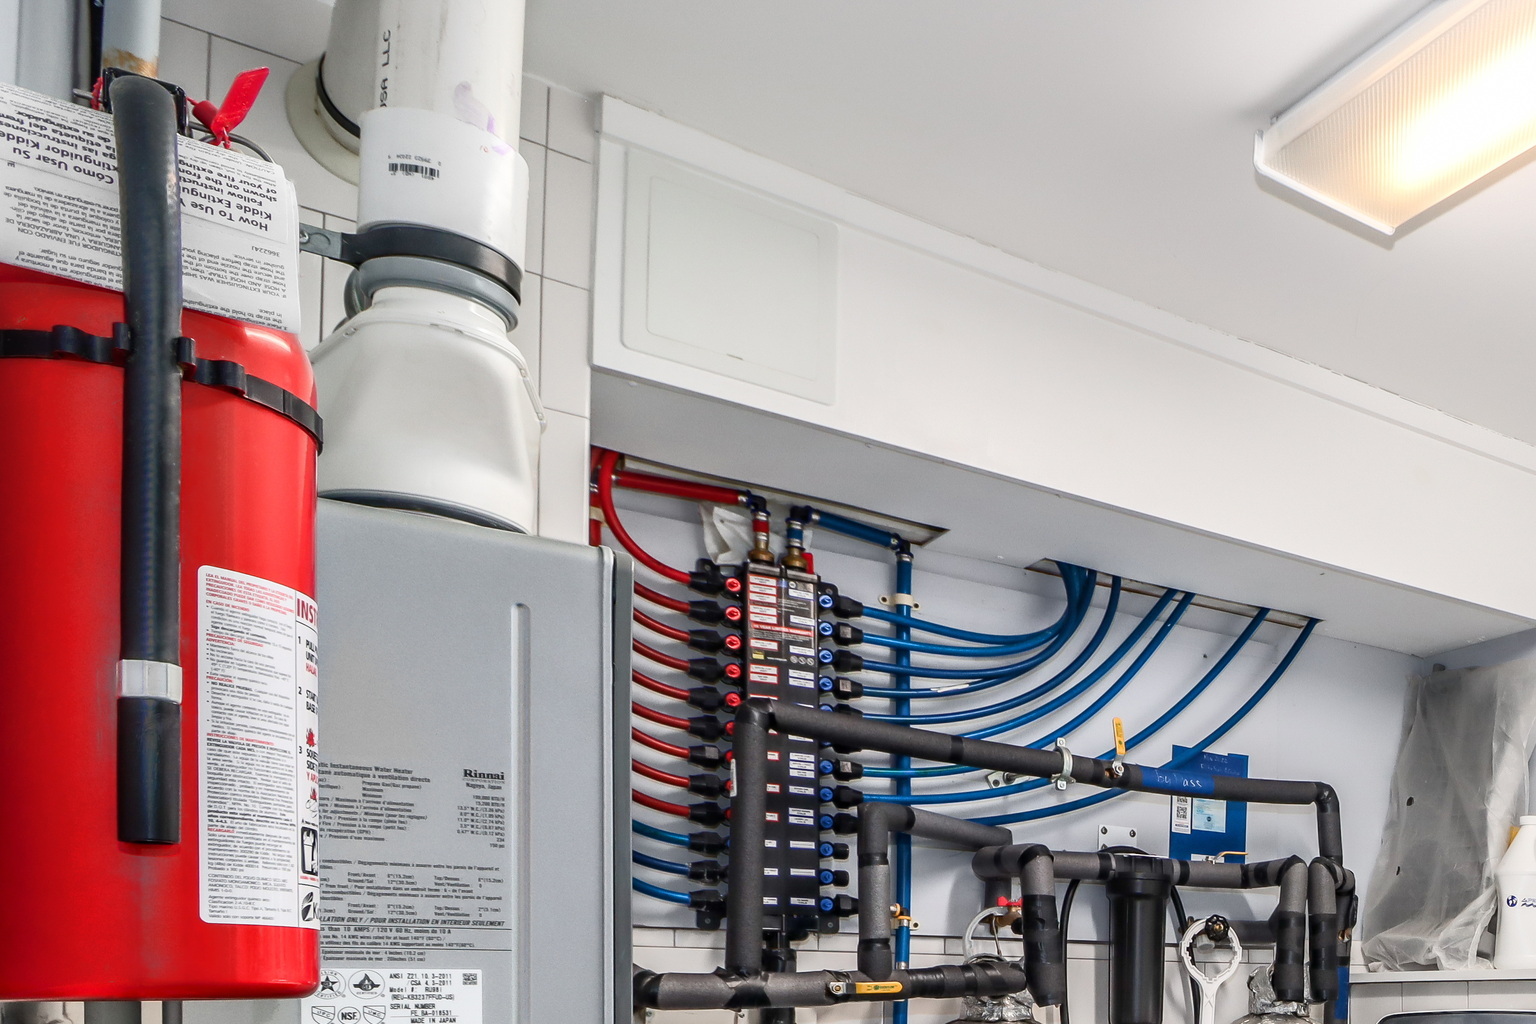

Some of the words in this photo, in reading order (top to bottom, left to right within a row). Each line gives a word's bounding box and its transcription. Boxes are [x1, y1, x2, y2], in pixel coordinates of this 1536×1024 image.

[382, 29, 391, 67] LLC
[0, 114, 24, 125] fren
[29, 122, 48, 131] del
[0, 131, 40, 150] Kidde
[52, 129, 101, 148] etiqueta
[97, 136, 110, 144] de
[12, 148, 30, 160] Su
[82, 146, 98, 156] las
[36, 154, 68, 171] Usar
[44, 146, 119, 173] xtinguidor
[179, 160, 214, 174] exting
[73, 166, 114, 184] Cómo
[179, 168, 201, 180] fron
[217, 172, 236, 182] fire
[180, 176, 224, 194] instructi
[205, 176, 222, 186] the
[226, 182, 240, 190] on
[239, 180, 262, 190] your
[180, 187, 231, 208] Extingu
[227, 191, 262, 206] Follow
[243, 188, 278, 202] shown
[191, 201, 214, 216] Use
[236, 204, 272, 221] Kidde
[219, 210, 234, 222] To
[239, 216, 268, 232] How
[17, 227, 34, 236] CON
[34, 232, 66, 244] ENVIADO
[199, 274, 214, 283] WAS
[230, 276, 246, 284] HOSE
[248, 280, 262, 288] AND
[216, 280, 260, 292] EXTINGUISHER
[220, 307, 230, 315] the
[232, 310, 246, 318] hold
[255, 312, 271, 322] strap
[297, 598, 316, 626] INST
[463, 768, 505, 780] Rinnai
